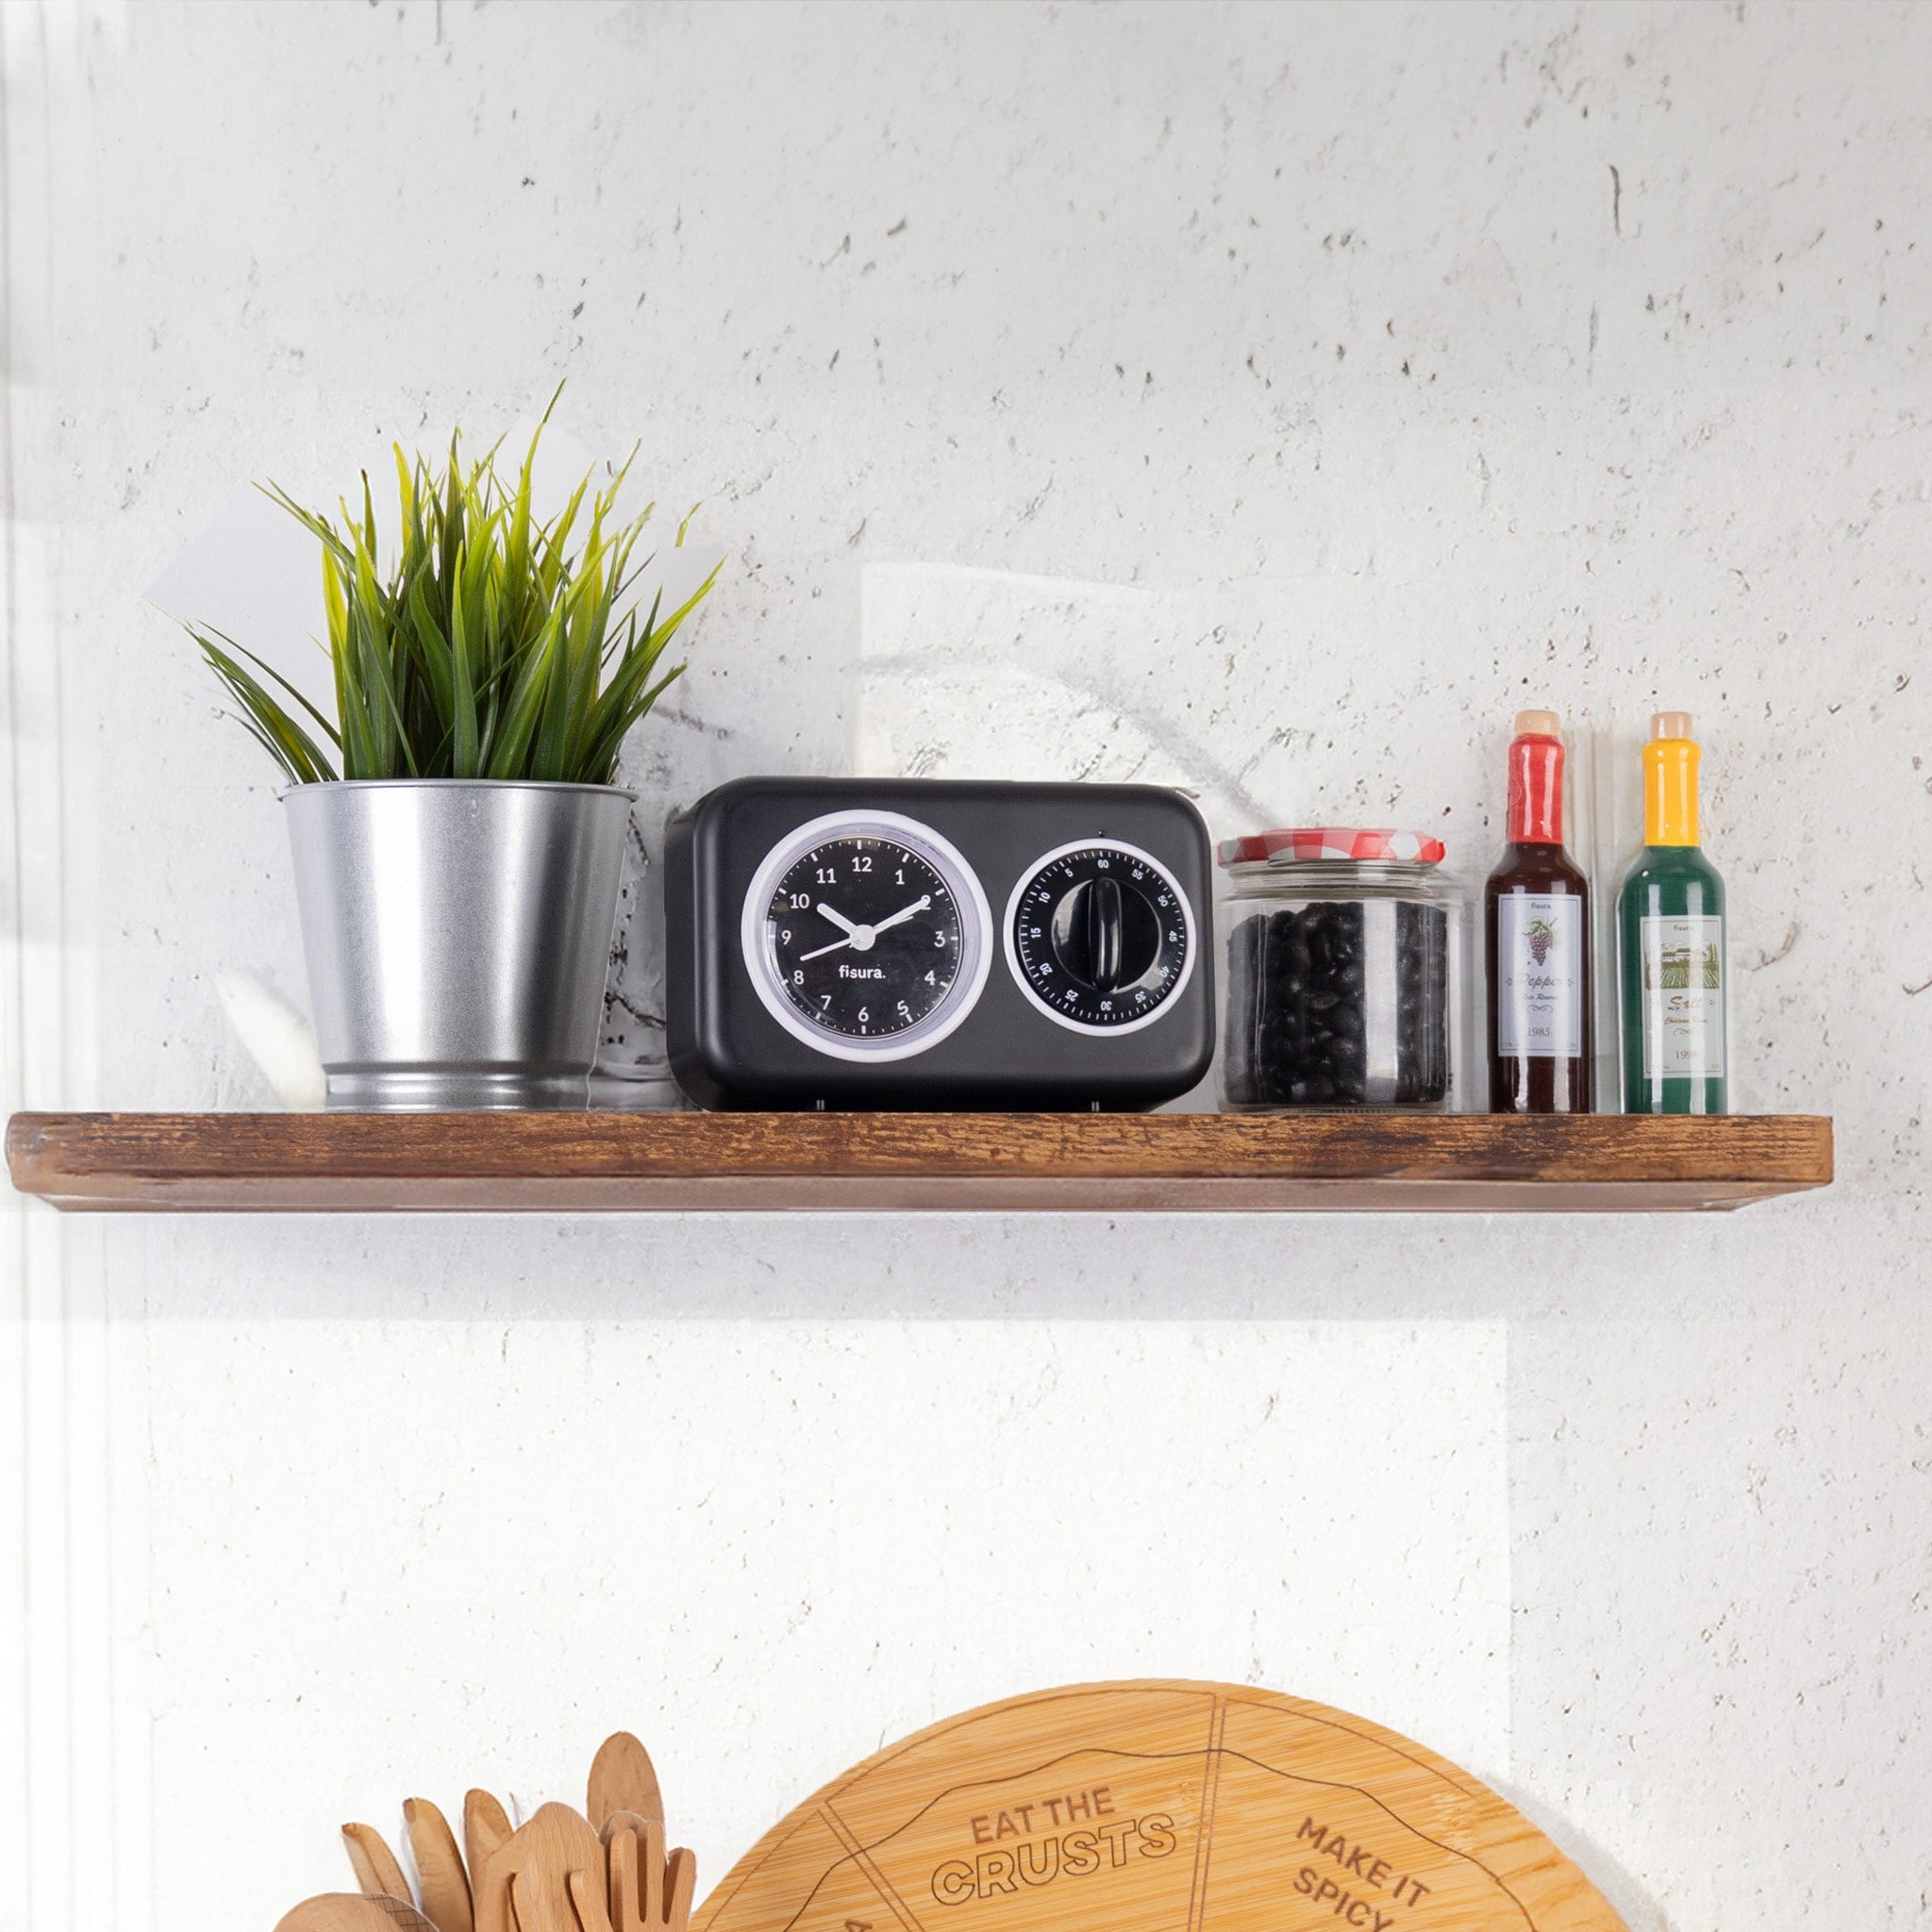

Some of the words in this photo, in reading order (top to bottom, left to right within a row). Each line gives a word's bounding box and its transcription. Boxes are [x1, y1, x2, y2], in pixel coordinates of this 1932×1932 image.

[852, 857, 873, 873] 12
[1097, 859, 1109, 869] 60
[816, 868, 837, 884] 11
[895, 870, 906, 885] 1
[1065, 868, 1074, 877] 5
[1131, 868, 1144, 880] 55
[790, 893, 810, 909] 10
[919, 894, 931, 910] 2
[1039, 891, 1051, 904] 10
[1158, 894, 1169, 908] 50
[781, 929, 792, 945] 9
[933, 930, 946, 948] 3
[1030, 926, 1041, 939] 15
[1168, 929, 1178, 943] 45
[838, 965, 886, 979] fisura.
[1040, 962, 1053, 976] 20
[1159, 965, 1170, 978] 40
[793, 970, 804, 985] 8
[924, 970, 936, 986] 4
[821, 995, 832, 1010] 7
[1064, 989, 1079, 1003] 25
[1134, 991, 1146, 1003] 35
[1667, 995, 1702, 1011] Salt
[896, 1000, 909, 1016] 5
[1100, 1001, 1113, 1011] 30
[858, 1007, 869, 1022] 6
[1527, 1026, 1551, 1037] 1985
[970, 1804, 1035, 1844] EAT
[1041, 1787, 1115, 1826] THE
[931, 1813, 1176, 1906] CRUSTS
[1296, 1816, 1392, 1890] MAKE
[1392, 1875, 1431, 1907] IT
[1292, 1867, 1394, 1932] SPICY
